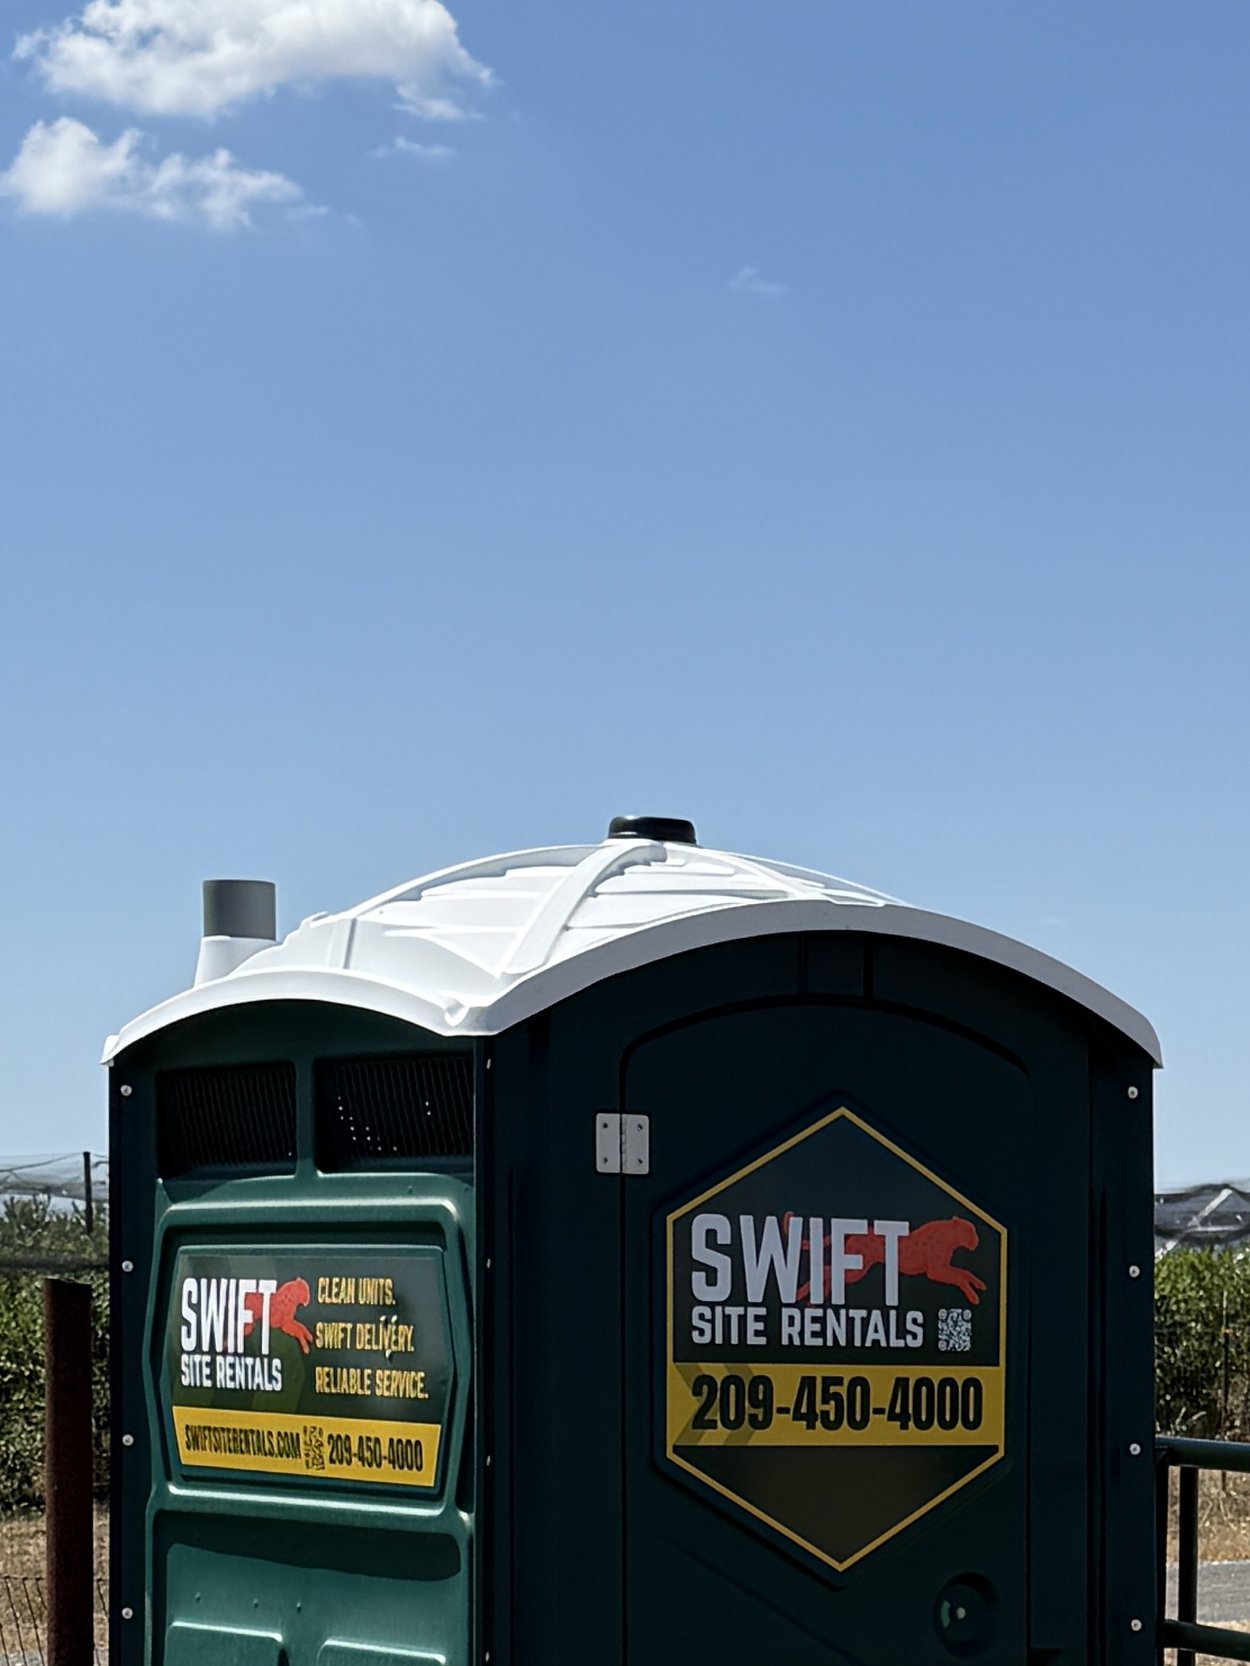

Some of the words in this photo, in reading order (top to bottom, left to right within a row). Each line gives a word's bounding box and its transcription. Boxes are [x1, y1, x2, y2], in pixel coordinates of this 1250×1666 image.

[691, 1213, 910, 1306] SWIFT
[317, 1277, 355, 1304] CLEAN
[358, 1278, 396, 1305] UNITS.
[180, 1277, 277, 1355] SWIFT
[691, 1306, 767, 1345] SITE
[781, 1308, 924, 1348] RENTALS
[315, 1321, 353, 1349] SWIFT
[355, 1322, 415, 1352] DELIVERY.
[181, 1353, 212, 1386] SITE
[216, 1356, 282, 1391] RENTALS
[315, 1366, 372, 1396] RELIABLE
[375, 1370, 429, 1399] SERVICE.
[691, 1374, 983, 1432] 209-450-4000
[184, 1424, 302, 1460] SWIFTSITERENTALS.COM
[327, 1433, 423, 1472] 209-450-4000
